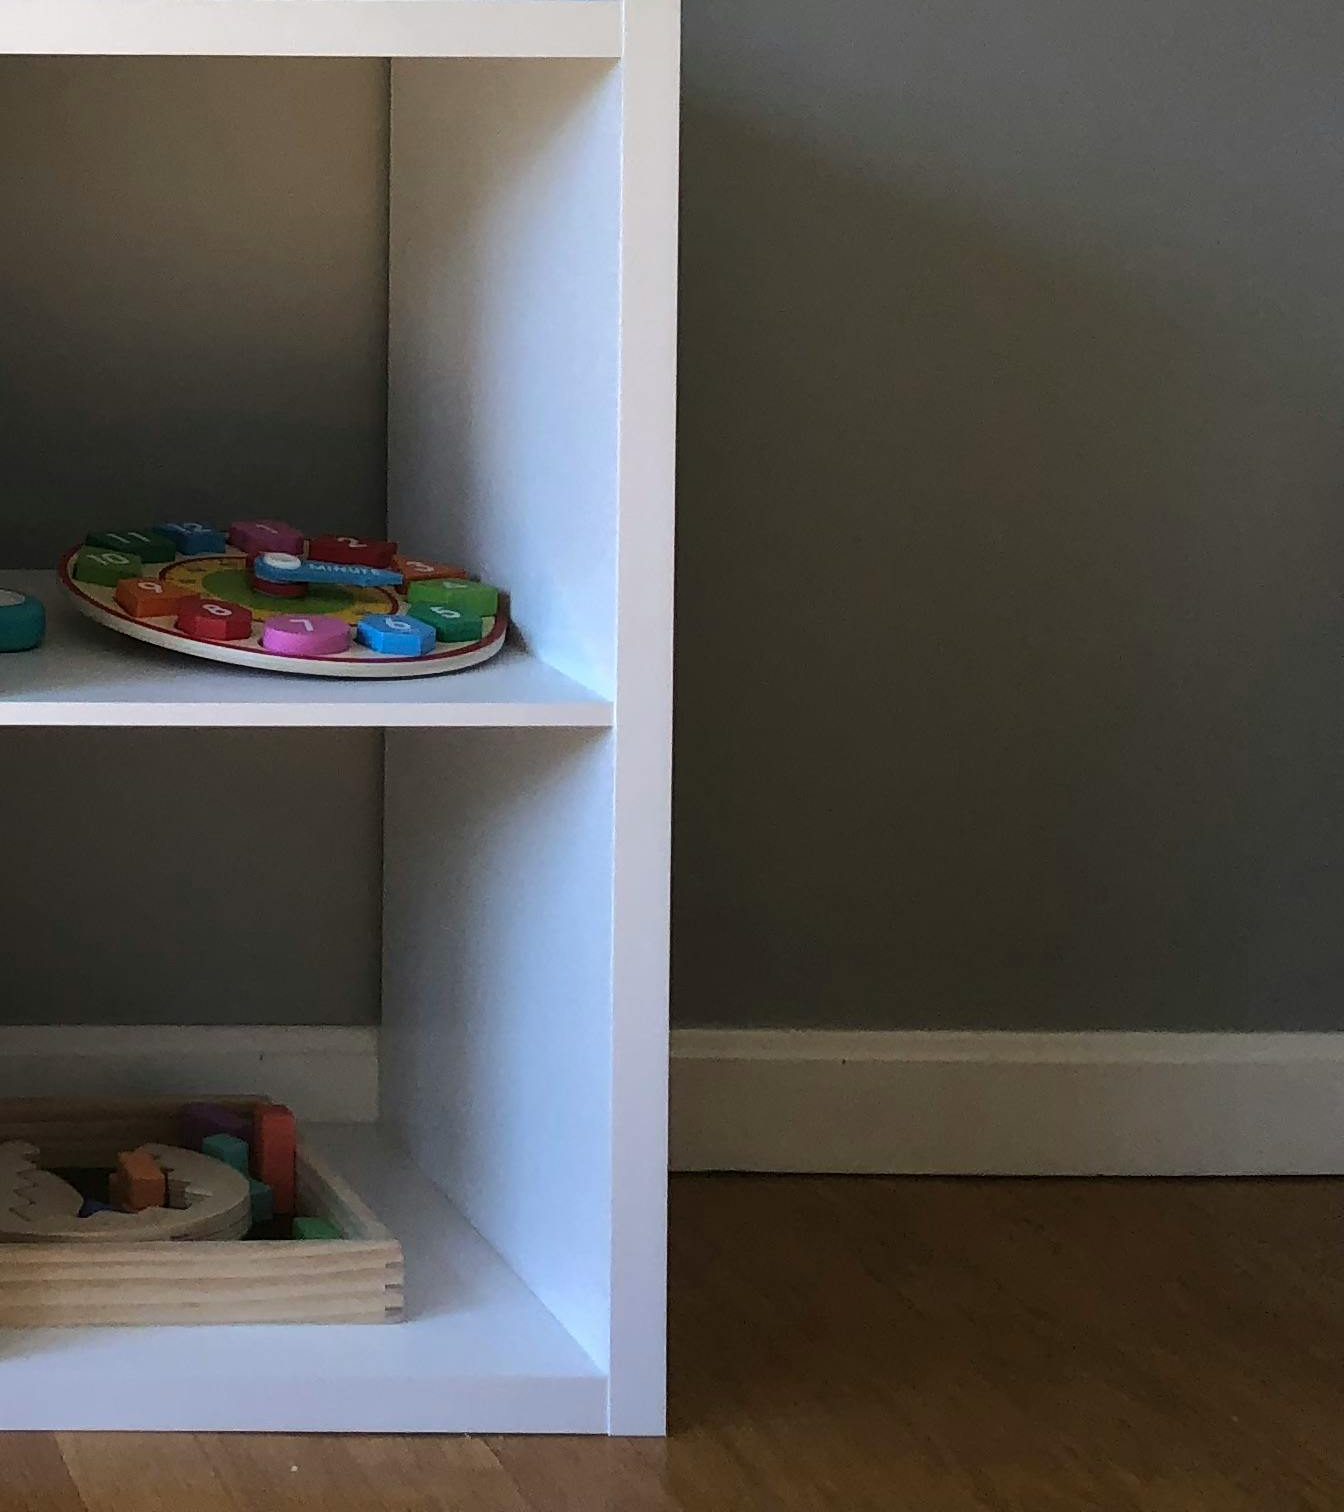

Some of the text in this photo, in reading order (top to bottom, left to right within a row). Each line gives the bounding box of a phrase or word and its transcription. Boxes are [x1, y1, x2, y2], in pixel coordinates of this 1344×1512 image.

[336, 536, 368, 548] 2
[86, 553, 131, 567] 10
[405, 560, 435, 573] 3
[308, 562, 381, 576] MINUTE
[137, 581, 163, 594] 9
[202, 603, 233, 616] 8
[429, 605, 461, 619] 5
[289, 618, 314, 632] 7
[385, 616, 412, 631] 6
